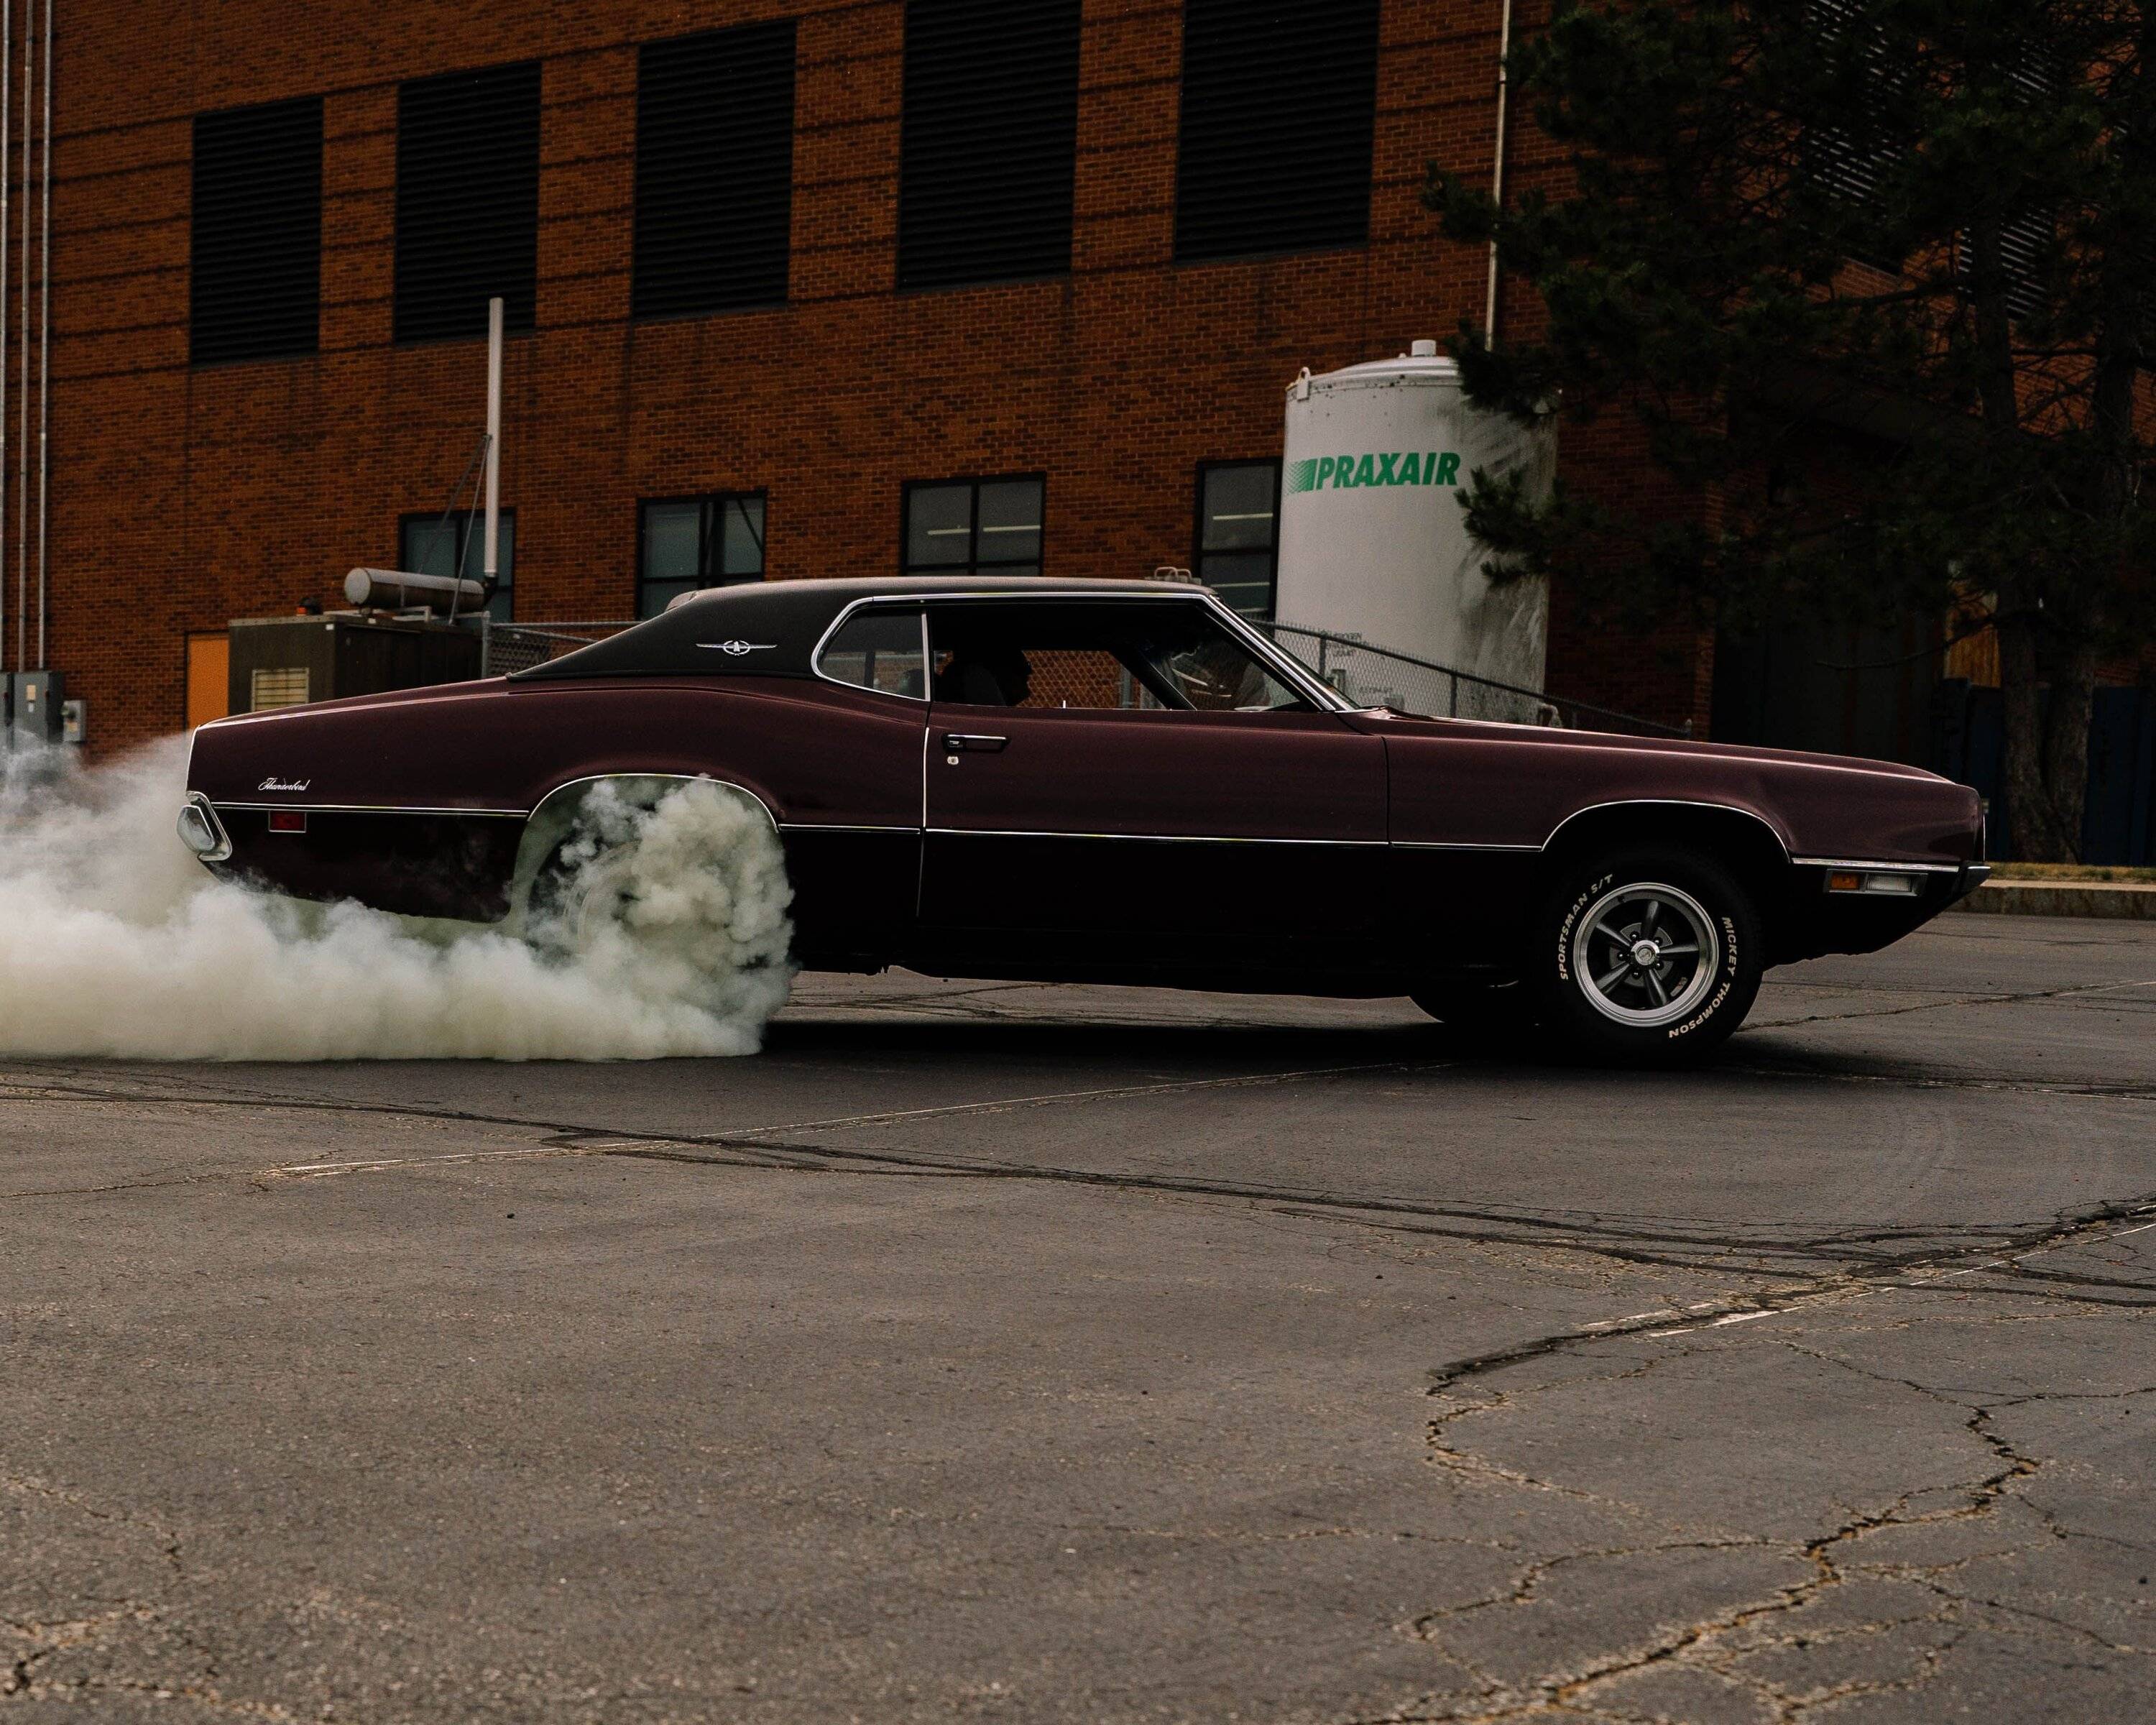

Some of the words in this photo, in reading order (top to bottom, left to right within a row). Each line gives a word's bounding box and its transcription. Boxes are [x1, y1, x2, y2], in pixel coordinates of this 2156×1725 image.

[1315, 452, 1461, 490] PRAXAIR
[1558, 893, 1588, 980] SPORTSMAN
[1591, 873, 1613, 894] S/T
[1722, 916, 1737, 977] MICKEY
[1668, 982, 1731, 1038] THOMPSON
